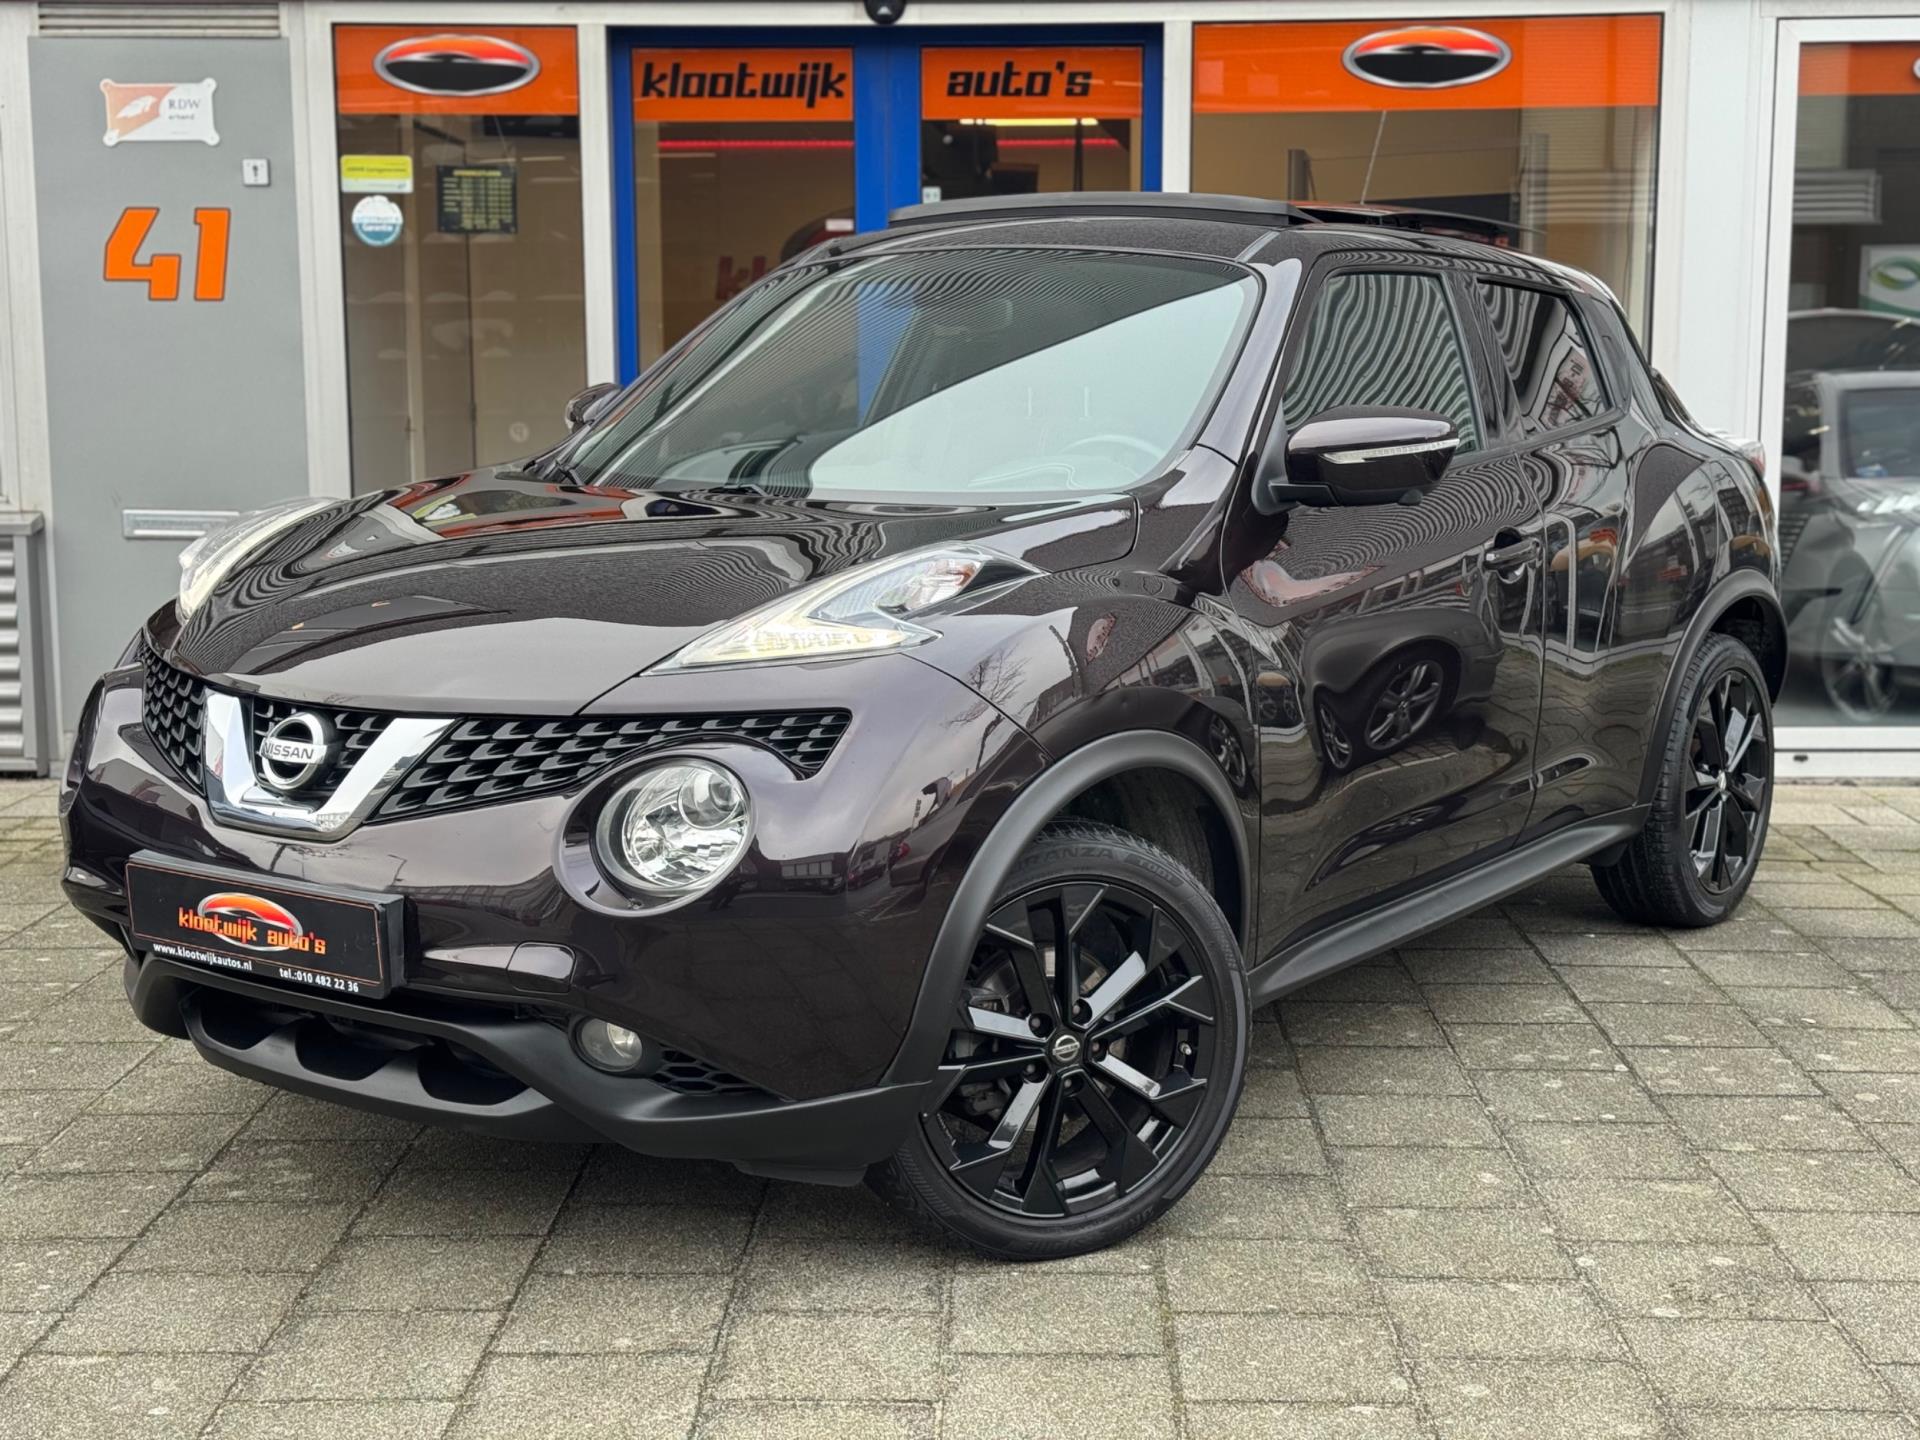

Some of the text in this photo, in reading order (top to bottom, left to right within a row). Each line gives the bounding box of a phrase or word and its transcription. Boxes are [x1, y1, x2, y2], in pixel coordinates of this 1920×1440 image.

[640, 61, 847, 109] klootwijk
[947, 60, 1091, 98] auto's
[168, 98, 202, 110] RDW
[104, 207, 230, 301] 41
[263, 741, 315, 760] NISSAN
[178, 907, 326, 954] klootwijk auto's
[153, 943, 252, 971] www.klootwijkautos.nl
[279, 967, 359, 993] tel.:010 482 22 36
